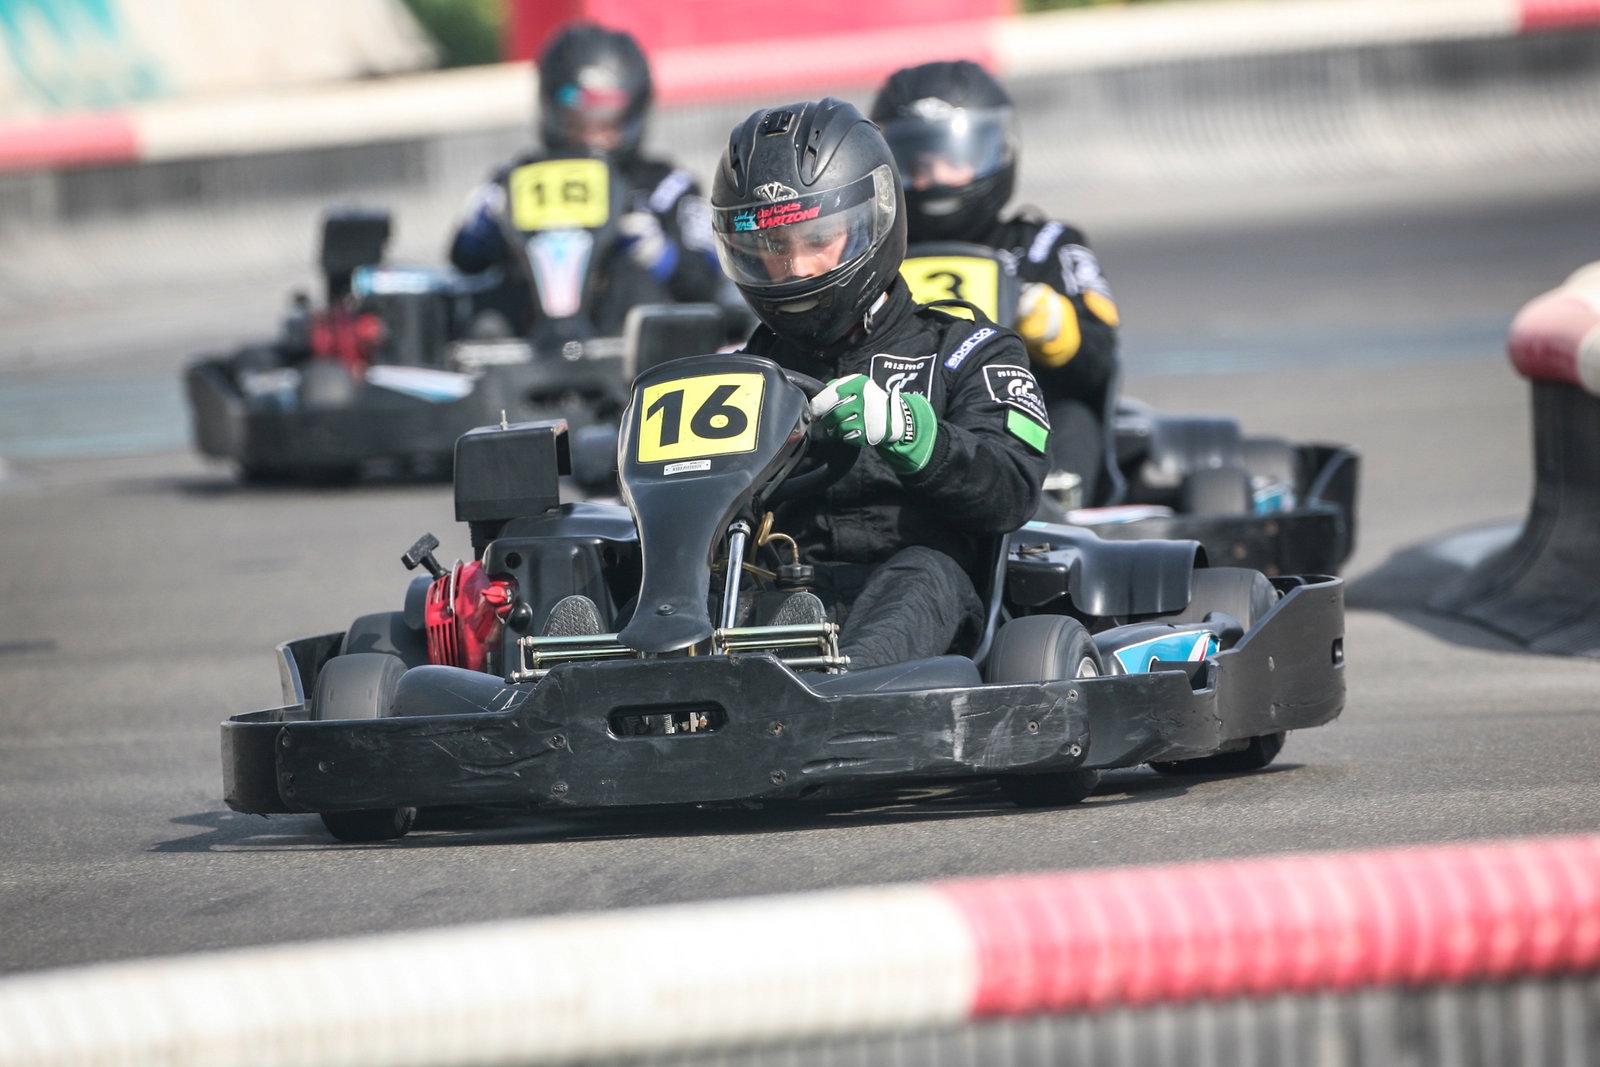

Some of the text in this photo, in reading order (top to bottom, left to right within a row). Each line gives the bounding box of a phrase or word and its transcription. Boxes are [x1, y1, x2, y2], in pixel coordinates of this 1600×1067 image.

[757, 206, 820, 229] KARTZONE
[947, 327, 992, 368] sparco
[645, 384, 748, 448] 16
